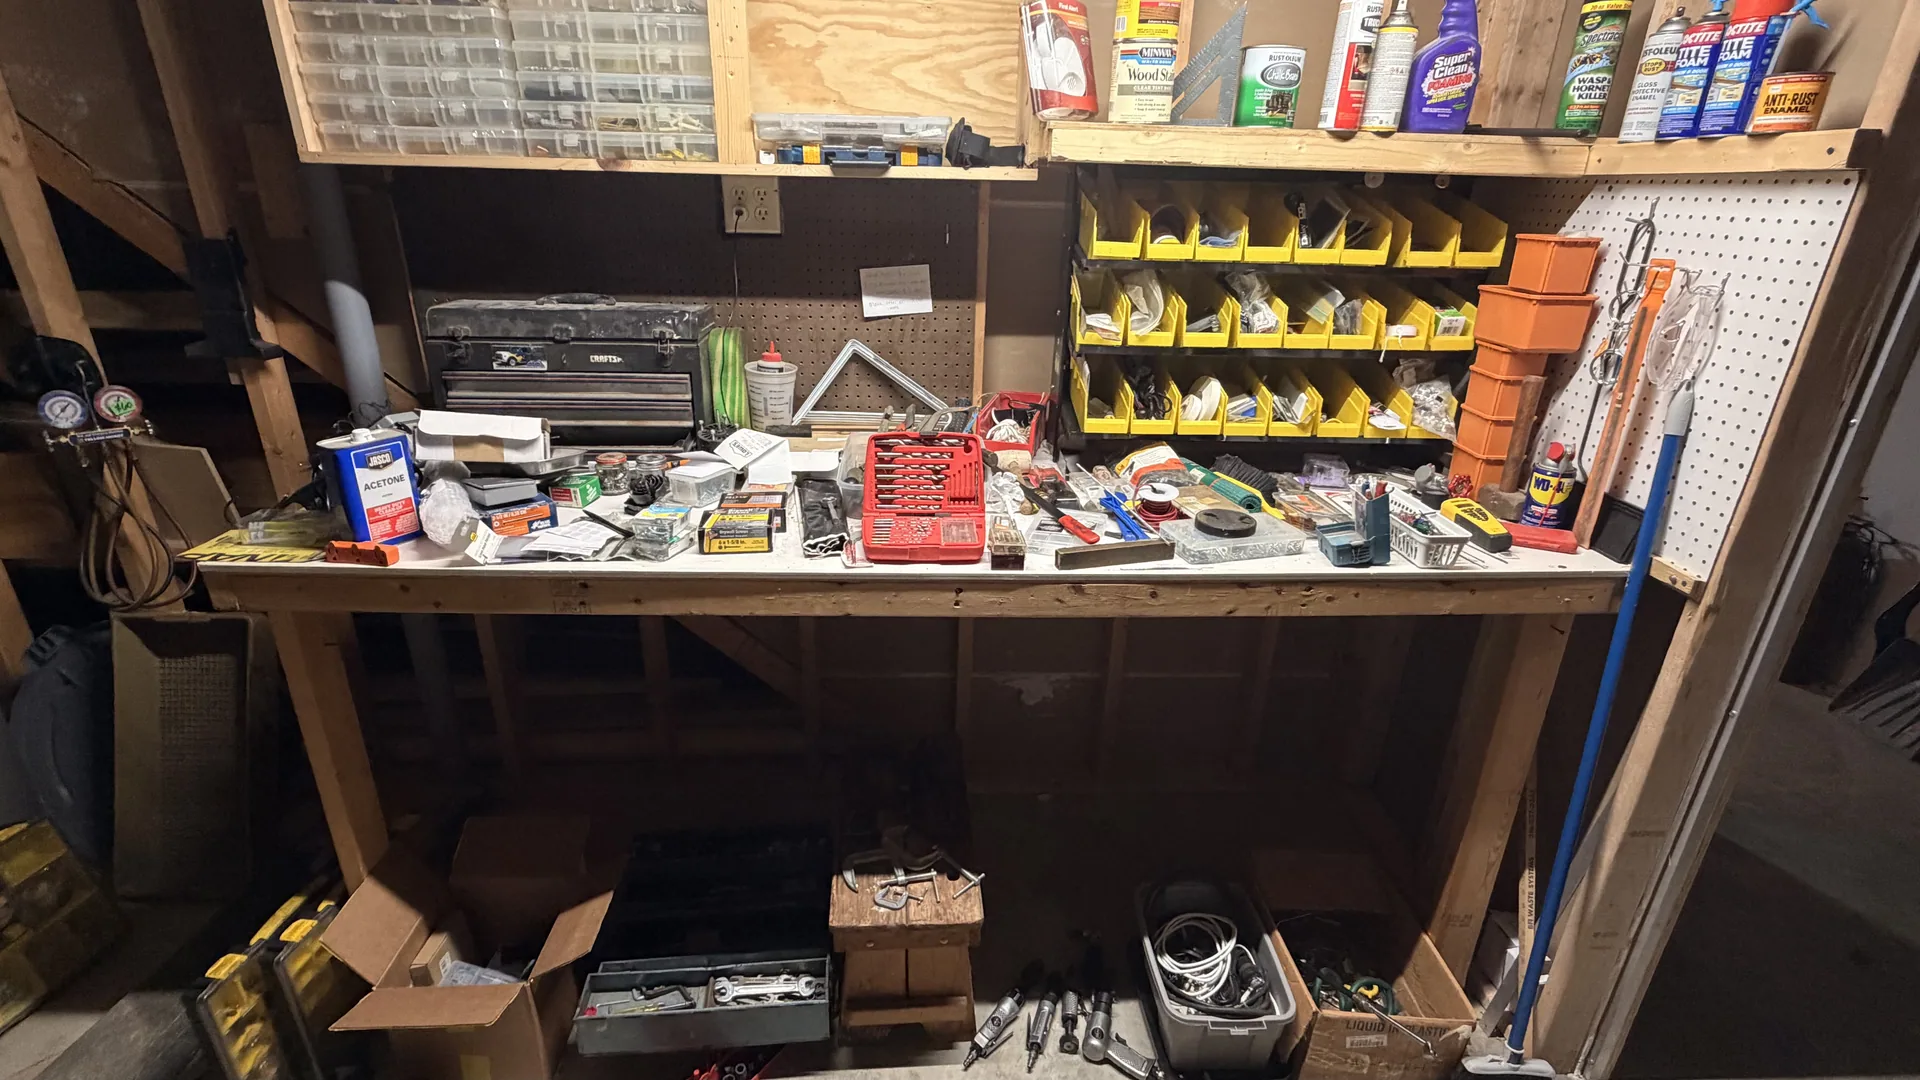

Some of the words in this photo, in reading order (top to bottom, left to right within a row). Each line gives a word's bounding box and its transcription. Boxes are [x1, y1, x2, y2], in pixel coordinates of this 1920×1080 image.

[1580, 31, 1622, 47] Spectrac
[1721, 36, 1757, 52] TITE
[1434, 52, 1471, 68] Super
[1678, 45, 1713, 60] TITE
[1719, 49, 1753, 61] FOAM
[1675, 57, 1710, 68] FOAM
[1128, 68, 1159, 81] Wood
[1434, 64, 1468, 79] Clean
[1427, 73, 1473, 92] FOAMING
[1763, 92, 1820, 107] ANTI-RUST
[1764, 106, 1811, 114] ENAMEL
[369, 453, 391, 467] JASCO
[364, 474, 405, 491] ACETONE
[1346, 1020, 1385, 1032] LIQUID
